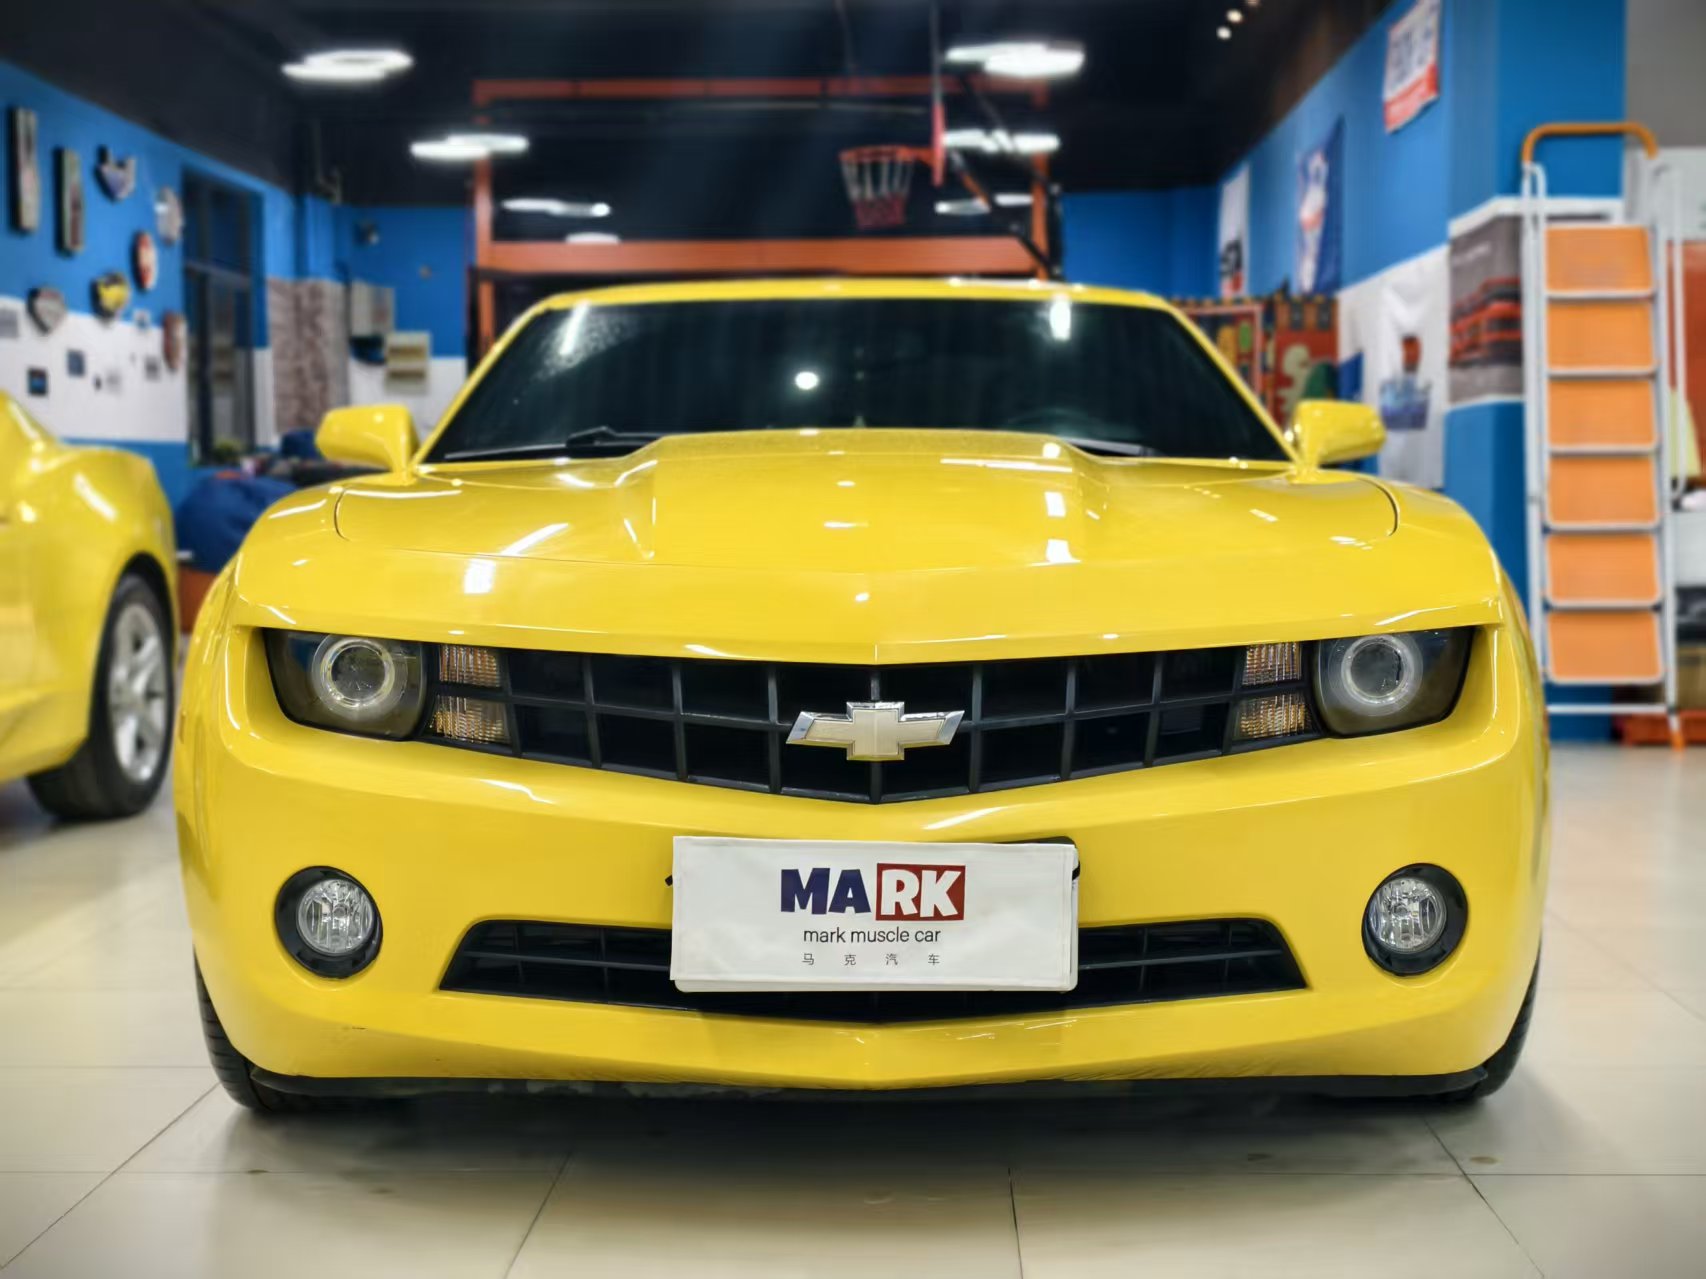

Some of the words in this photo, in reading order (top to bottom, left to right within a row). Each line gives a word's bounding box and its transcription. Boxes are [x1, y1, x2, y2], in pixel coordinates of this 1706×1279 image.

[781, 867, 962, 918] MARK
[803, 926, 846, 943] mark
[851, 926, 909, 943] muscle
[914, 928, 941, 943] car
[802, 952, 941, 966] 马克汽车
